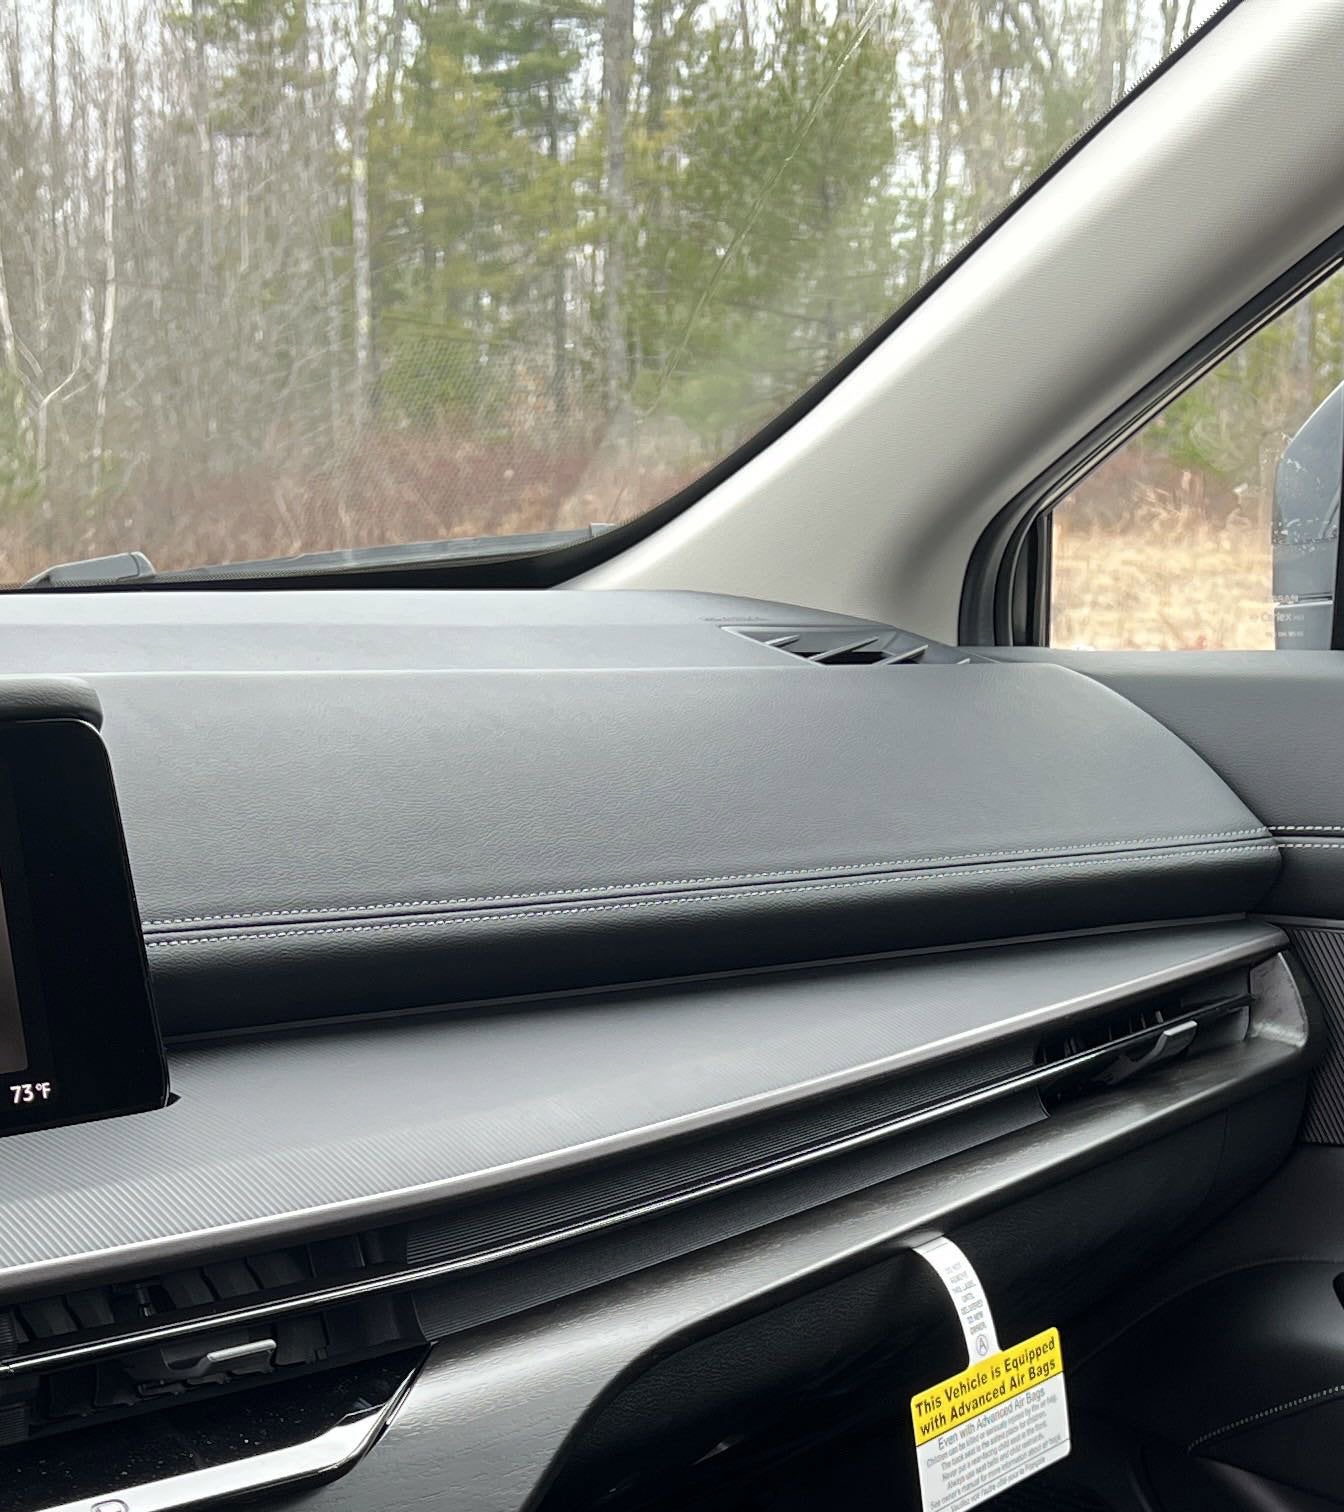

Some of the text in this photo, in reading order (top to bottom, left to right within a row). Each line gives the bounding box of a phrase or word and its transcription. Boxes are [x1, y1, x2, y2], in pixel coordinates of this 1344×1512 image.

[9, 1081, 52, 1104] 73°F
[916, 1337, 1055, 1417] This Vehicle is Equipped
[920, 1359, 1056, 1436] with Advanced Air Bags
[938, 1387, 1045, 1450] Even with Advanced Air Bags
